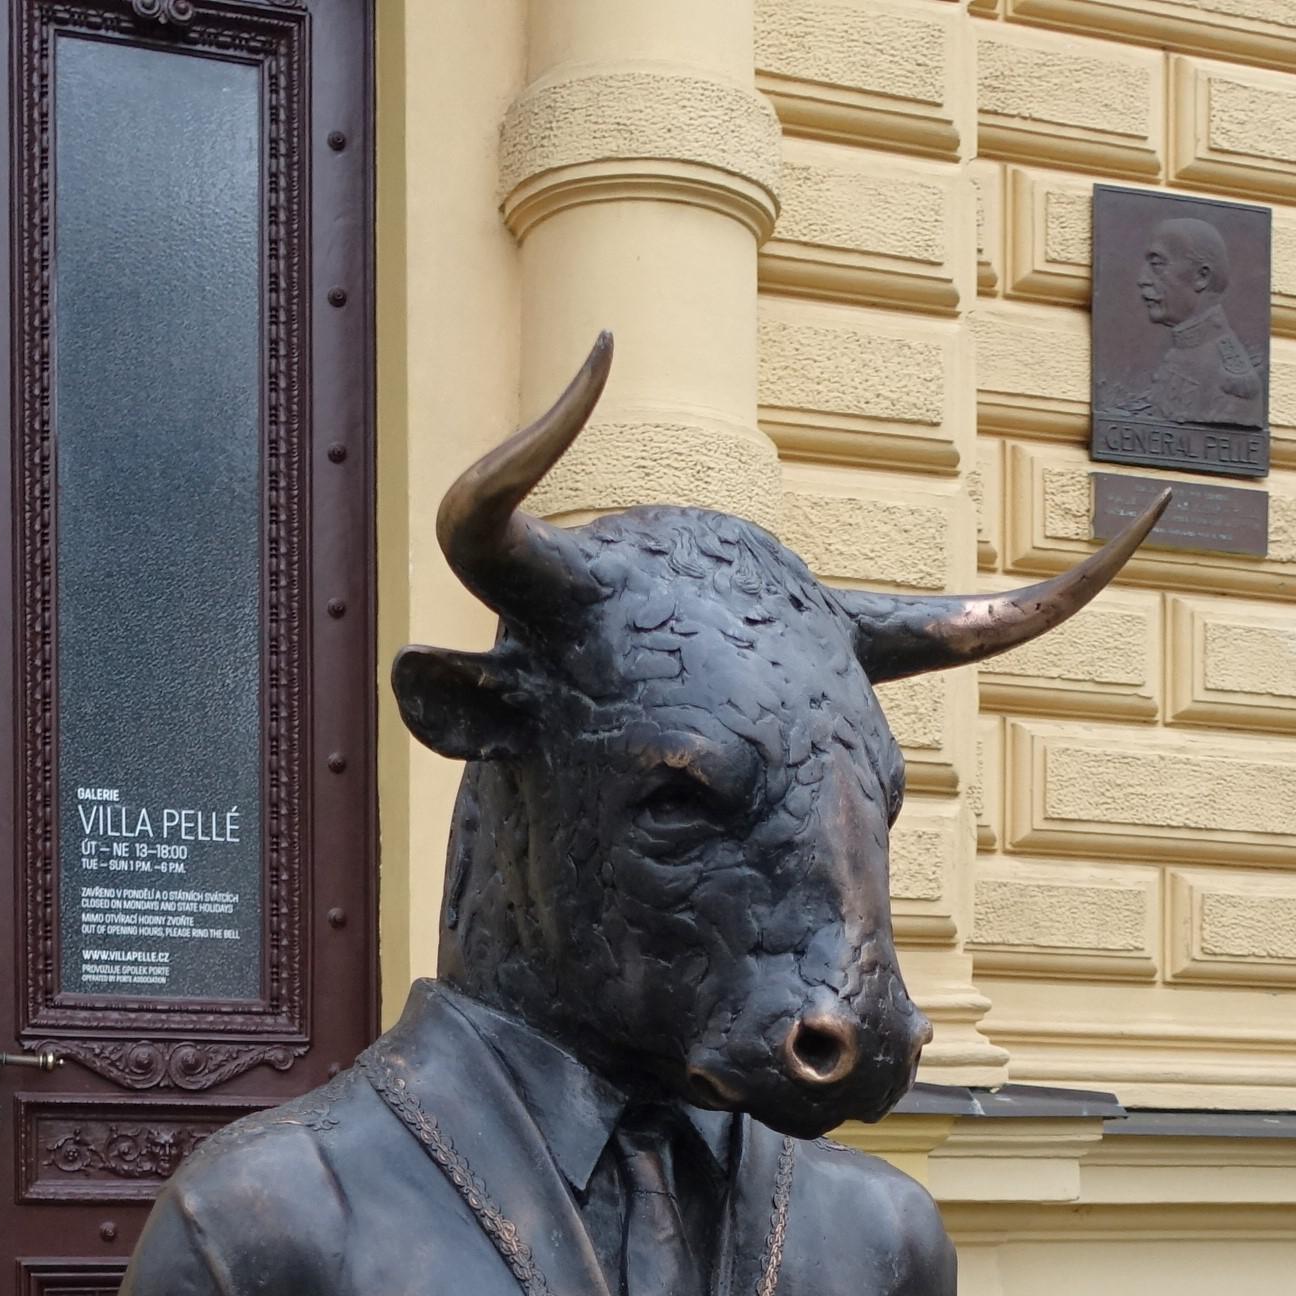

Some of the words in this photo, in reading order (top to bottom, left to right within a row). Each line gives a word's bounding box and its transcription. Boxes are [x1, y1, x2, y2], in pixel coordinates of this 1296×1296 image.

[77, 787, 120, 802] GALERIE
[77, 804, 154, 838] VILLA
[163, 805, 241, 843] PELLÉ
[81, 838, 98, 856] ÚT
[113, 842, 130, 857] NE
[81, 858, 99, 870] TUE
[109, 859, 128, 871] SUN
[81, 886, 116, 898] ZAVŘENO
[116, 888, 123, 898] V
[155, 889, 162, 901] A
[81, 898, 110, 909] CLOSED
[110, 899, 122, 909] ON
[123, 900, 159, 911] MONDAYS
[160, 901, 176, 912] AND
[177, 901, 199, 913] STATE
[199, 902, 234, 914] HOLIDAYS
[81, 912, 104, 923] MIMO
[138, 914, 166, 926] HODINY
[81, 924, 96, 935] OUT
[96, 924, 106, 935] OF
[106, 925, 137, 936] OPENING
[165, 927, 192, 938] PLEASE
[192, 927, 209, 938] RING
[209, 928, 223, 939] THE
[223, 929, 241, 940] BELL
[82, 949, 170, 963] WWW.VILLAPELLE.CZ
[81, 963, 121, 974] PROVOZUJE
[148, 966, 170, 976] PORTE
